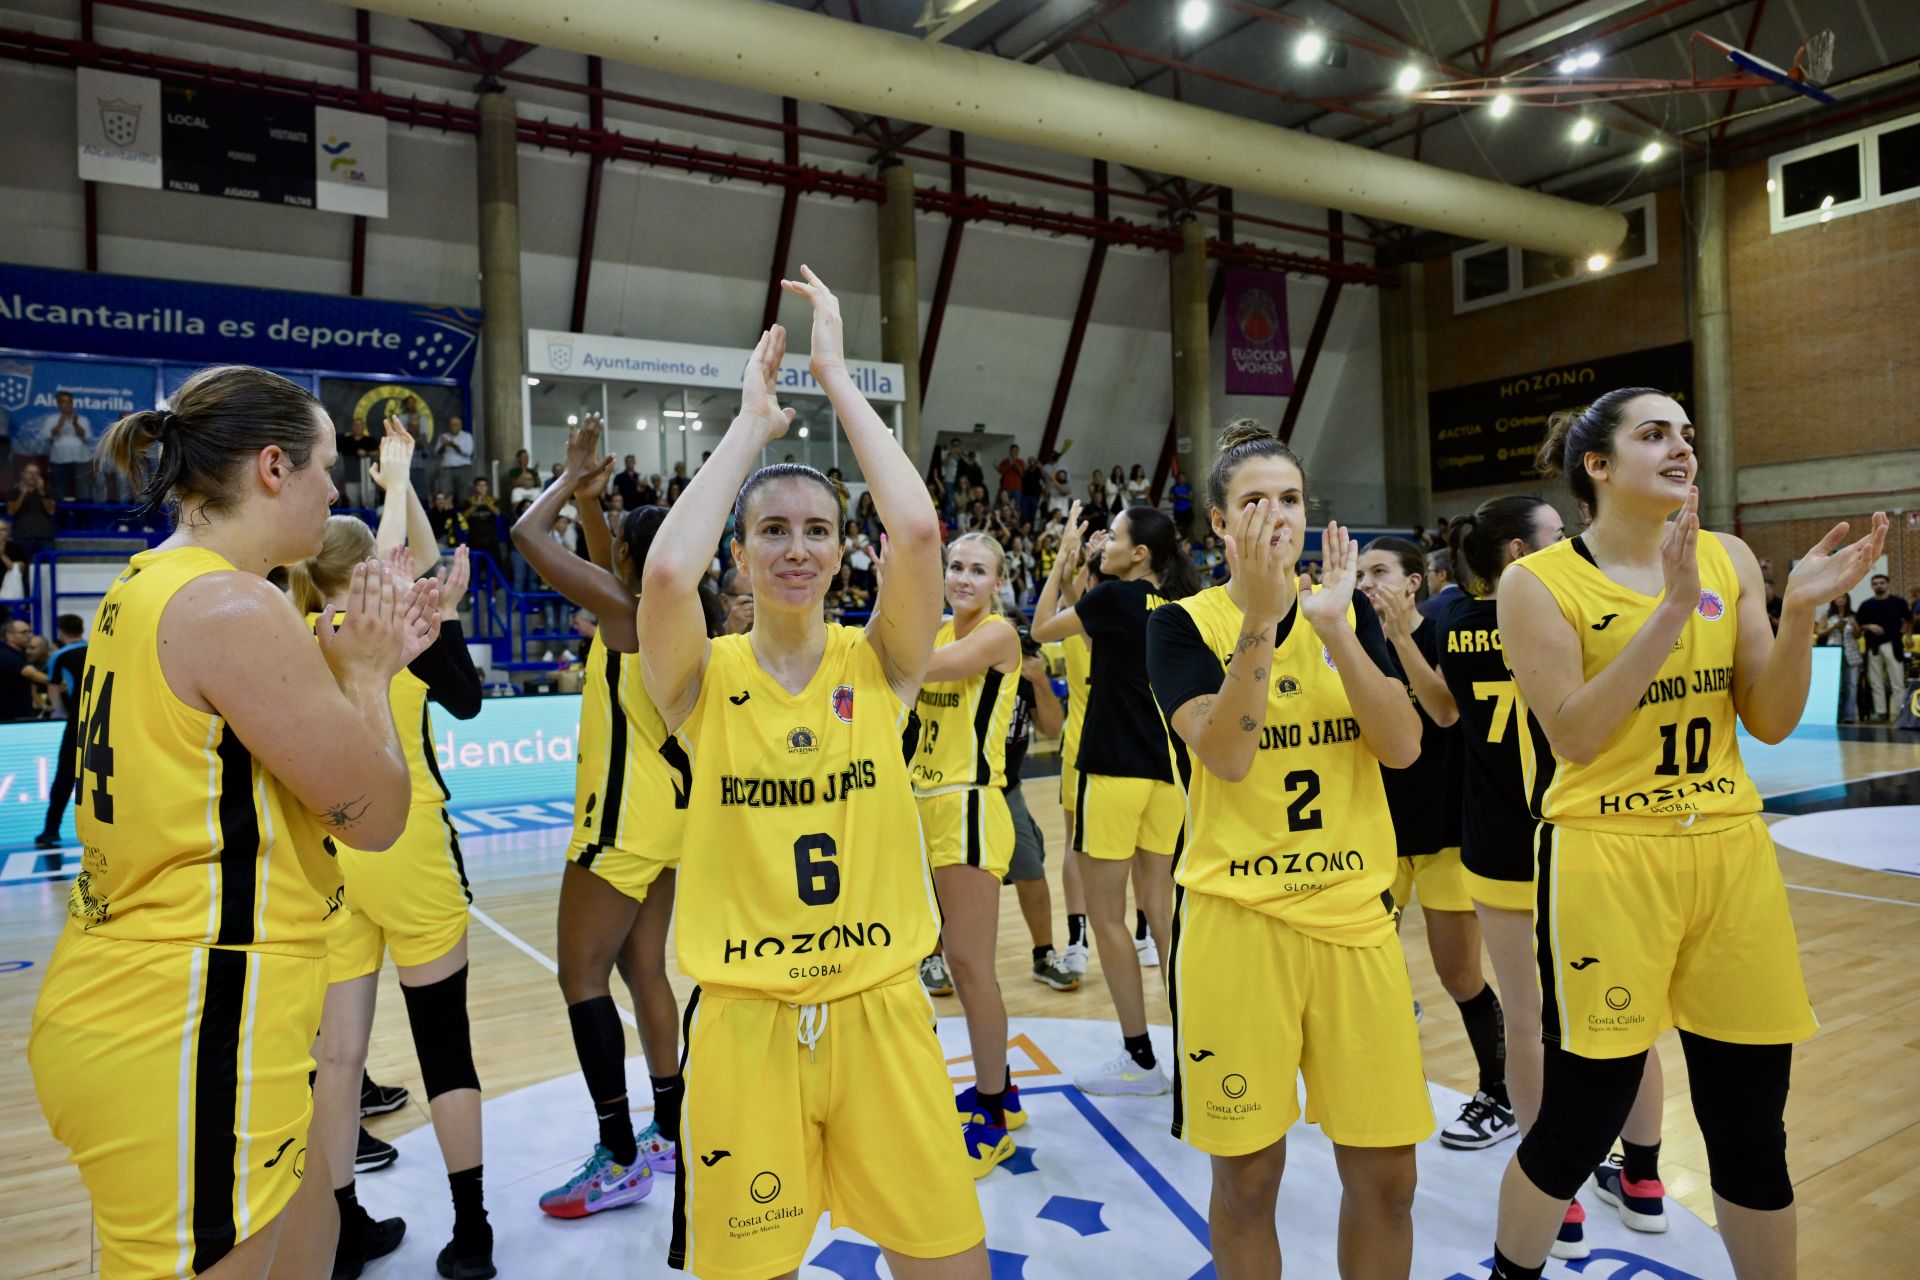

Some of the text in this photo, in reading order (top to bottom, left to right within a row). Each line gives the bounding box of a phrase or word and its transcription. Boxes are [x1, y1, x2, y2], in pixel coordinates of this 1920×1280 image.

[167, 112, 209, 129] LOCAL
[219, 318, 255, 339] es
[268, 317, 401, 349] deporte
[1231, 348, 1288, 363] EUROCUP
[1236, 360, 1284, 376] WOMEN
[582, 351, 893, 394] Ayuntamiento de canilla
[1499, 367, 1597, 399] HOZONO
[33, 392, 134, 412] Alntarilla
[1447, 628, 1502, 653] ARRO
[1634, 665, 1733, 710] ONO JAIRI
[1472, 680, 1516, 744] 7
[435, 723, 580, 771] dencial
[1259, 714, 1361, 750] ONO JAIR
[1655, 716, 1712, 776] 10
[720, 774, 816, 808] HOZONO
[1283, 769, 1323, 832] 2
[793, 832, 841, 907] 6
[1229, 850, 1364, 877] HOZONO
[724, 921, 892, 964] HOZONO
[788, 963, 842, 979] GLOBAL
[1588, 1015, 1614, 1025] Costa
[1206, 1100, 1232, 1114] Costa
[728, 1206, 804, 1229] Costa Cálida
[729, 1223, 780, 1240] Región de Murcia
